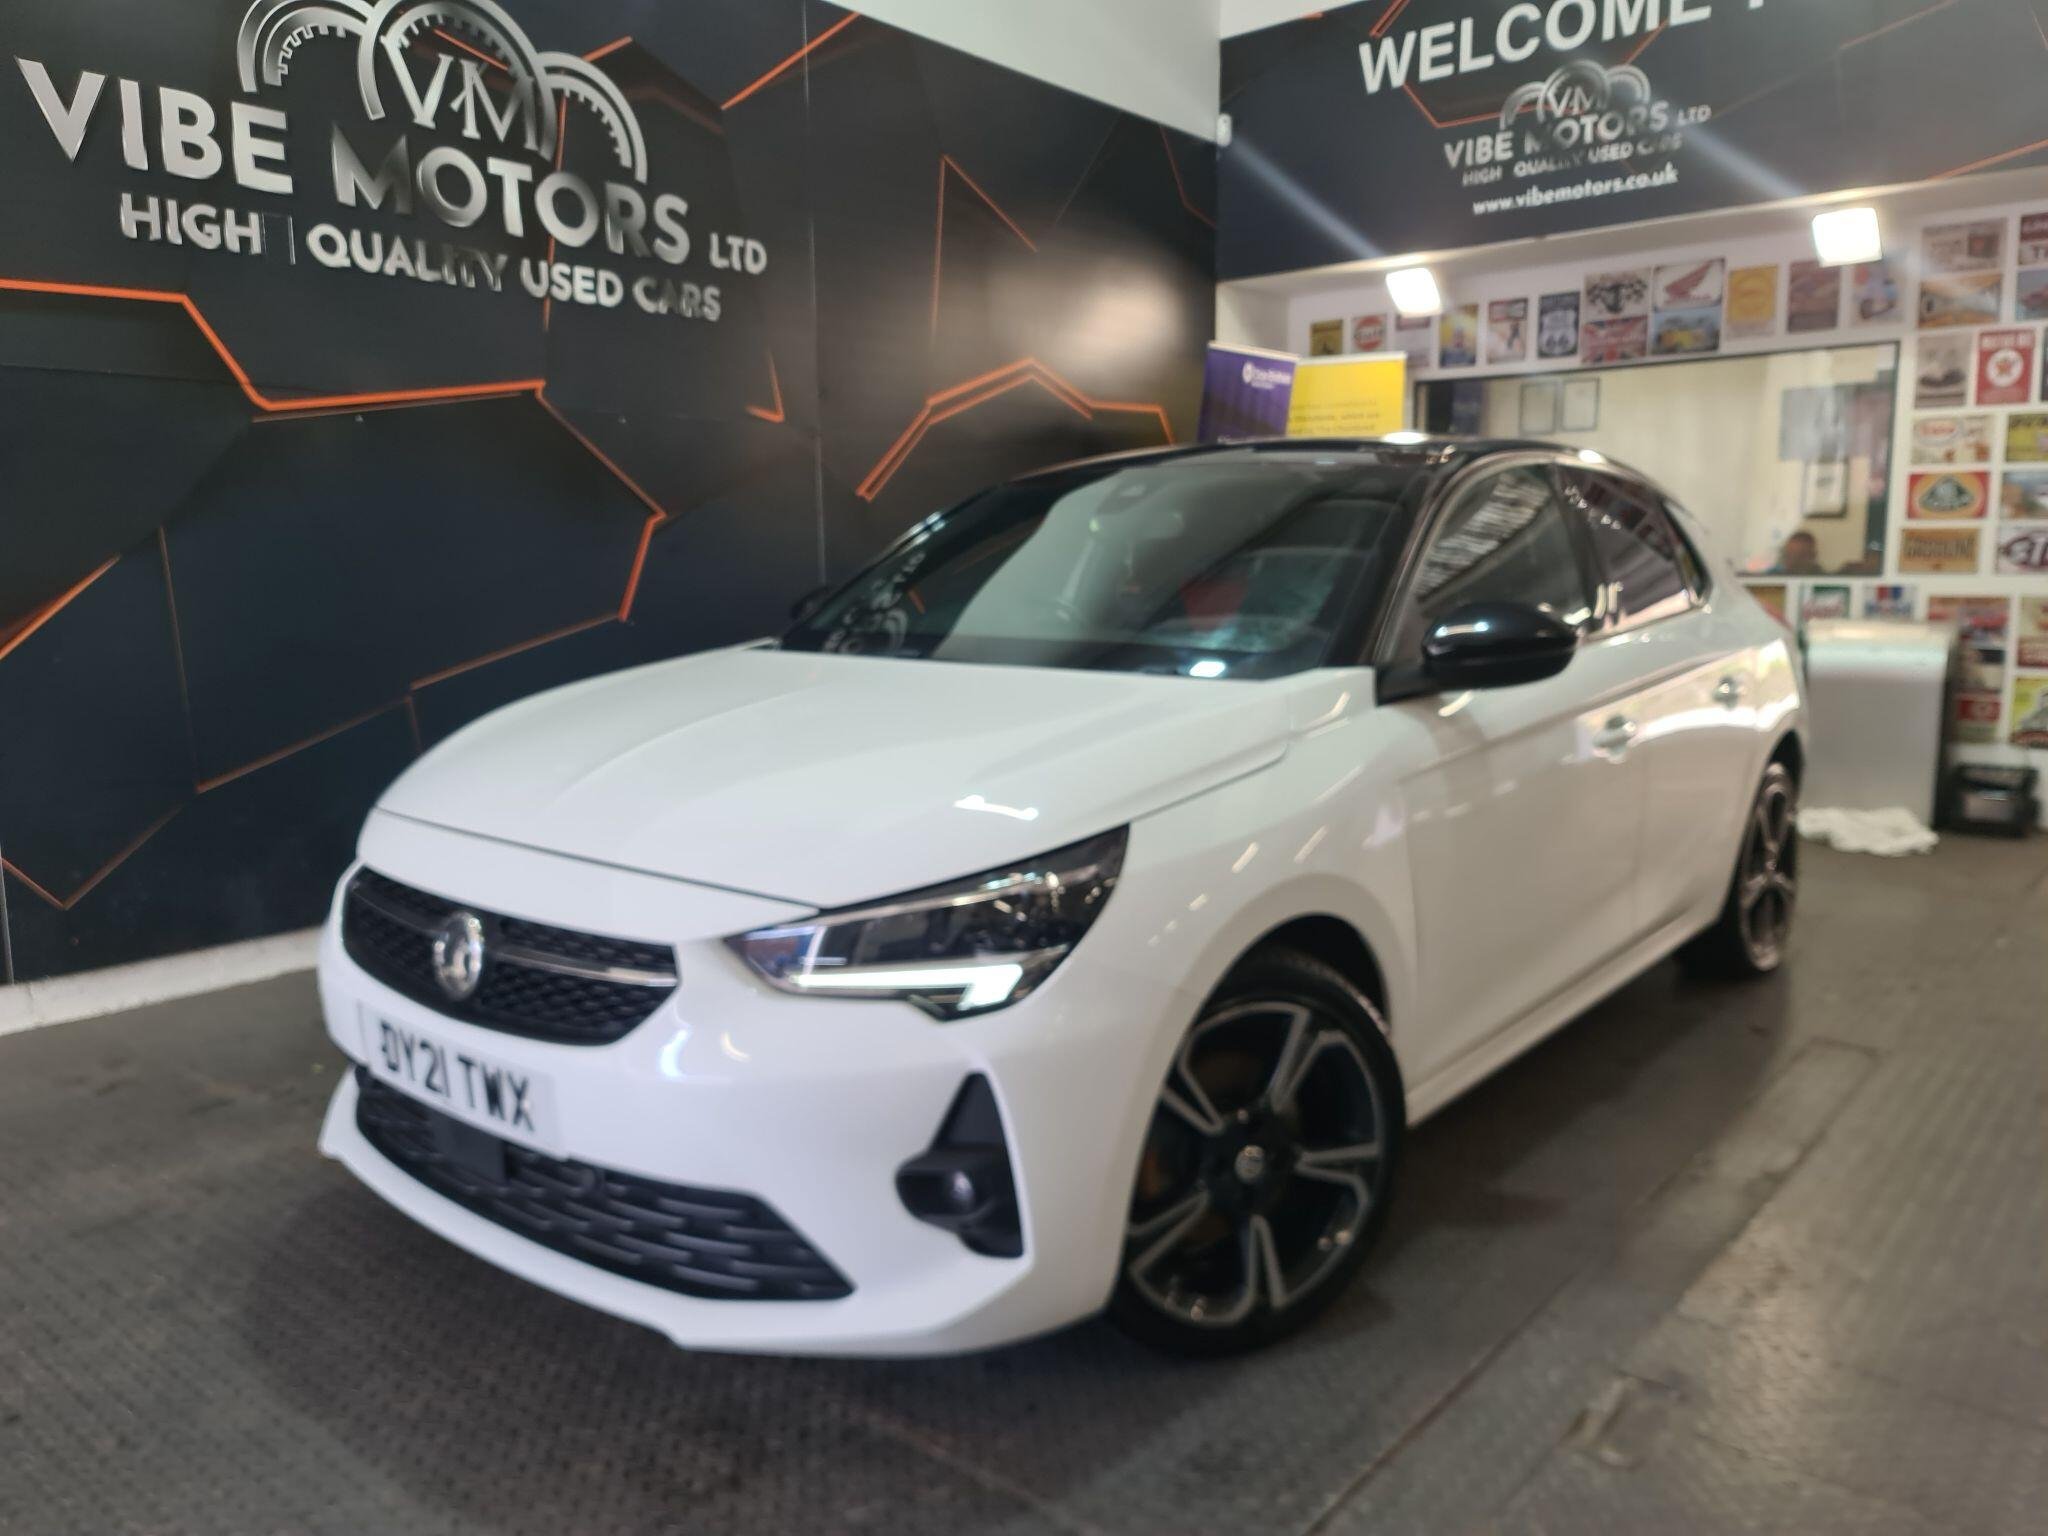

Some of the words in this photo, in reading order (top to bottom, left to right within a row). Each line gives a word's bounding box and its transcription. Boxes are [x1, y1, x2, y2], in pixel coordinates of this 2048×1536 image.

[14, 55, 294, 194] VIBE
[331, 122, 691, 265] MOTORS
[708, 232, 768, 275] LTD
[1444, 131, 1514, 168] VIBE
[1524, 100, 1669, 155] MOTORS
[1676, 104, 1712, 126] LTD
[1462, 164, 1503, 187] HIGH
[1587, 141, 1634, 165] USED
[1472, 161, 1680, 216] www.vibemotors.co.uk
[119, 192, 262, 255] HIGH
[305, 223, 507, 292] QUALITY
[520, 258, 624, 308] USED
[632, 276, 722, 322] CARS
[380, 1018, 451, 1098] DY21
[456, 1053, 534, 1132] TWX
